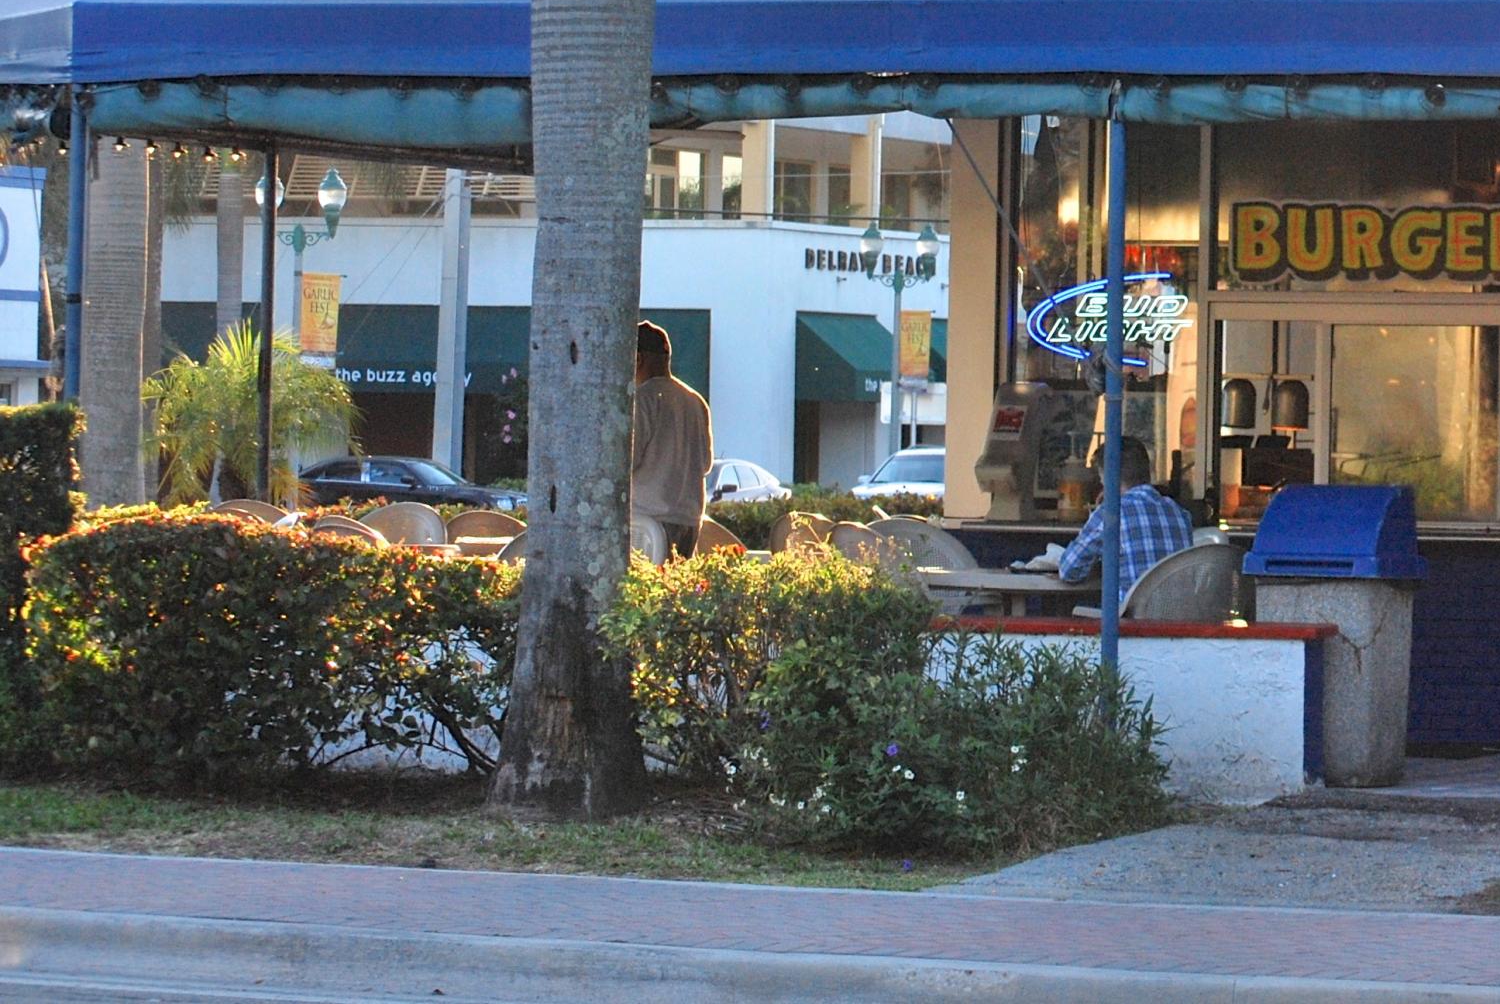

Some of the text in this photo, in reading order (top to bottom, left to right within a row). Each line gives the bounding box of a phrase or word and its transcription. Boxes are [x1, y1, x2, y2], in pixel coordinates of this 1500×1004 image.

[303, 286, 338, 301] GARLIC
[310, 300, 329, 315] FEST
[335, 367, 362, 383] the
[366, 368, 406, 383] buzz
